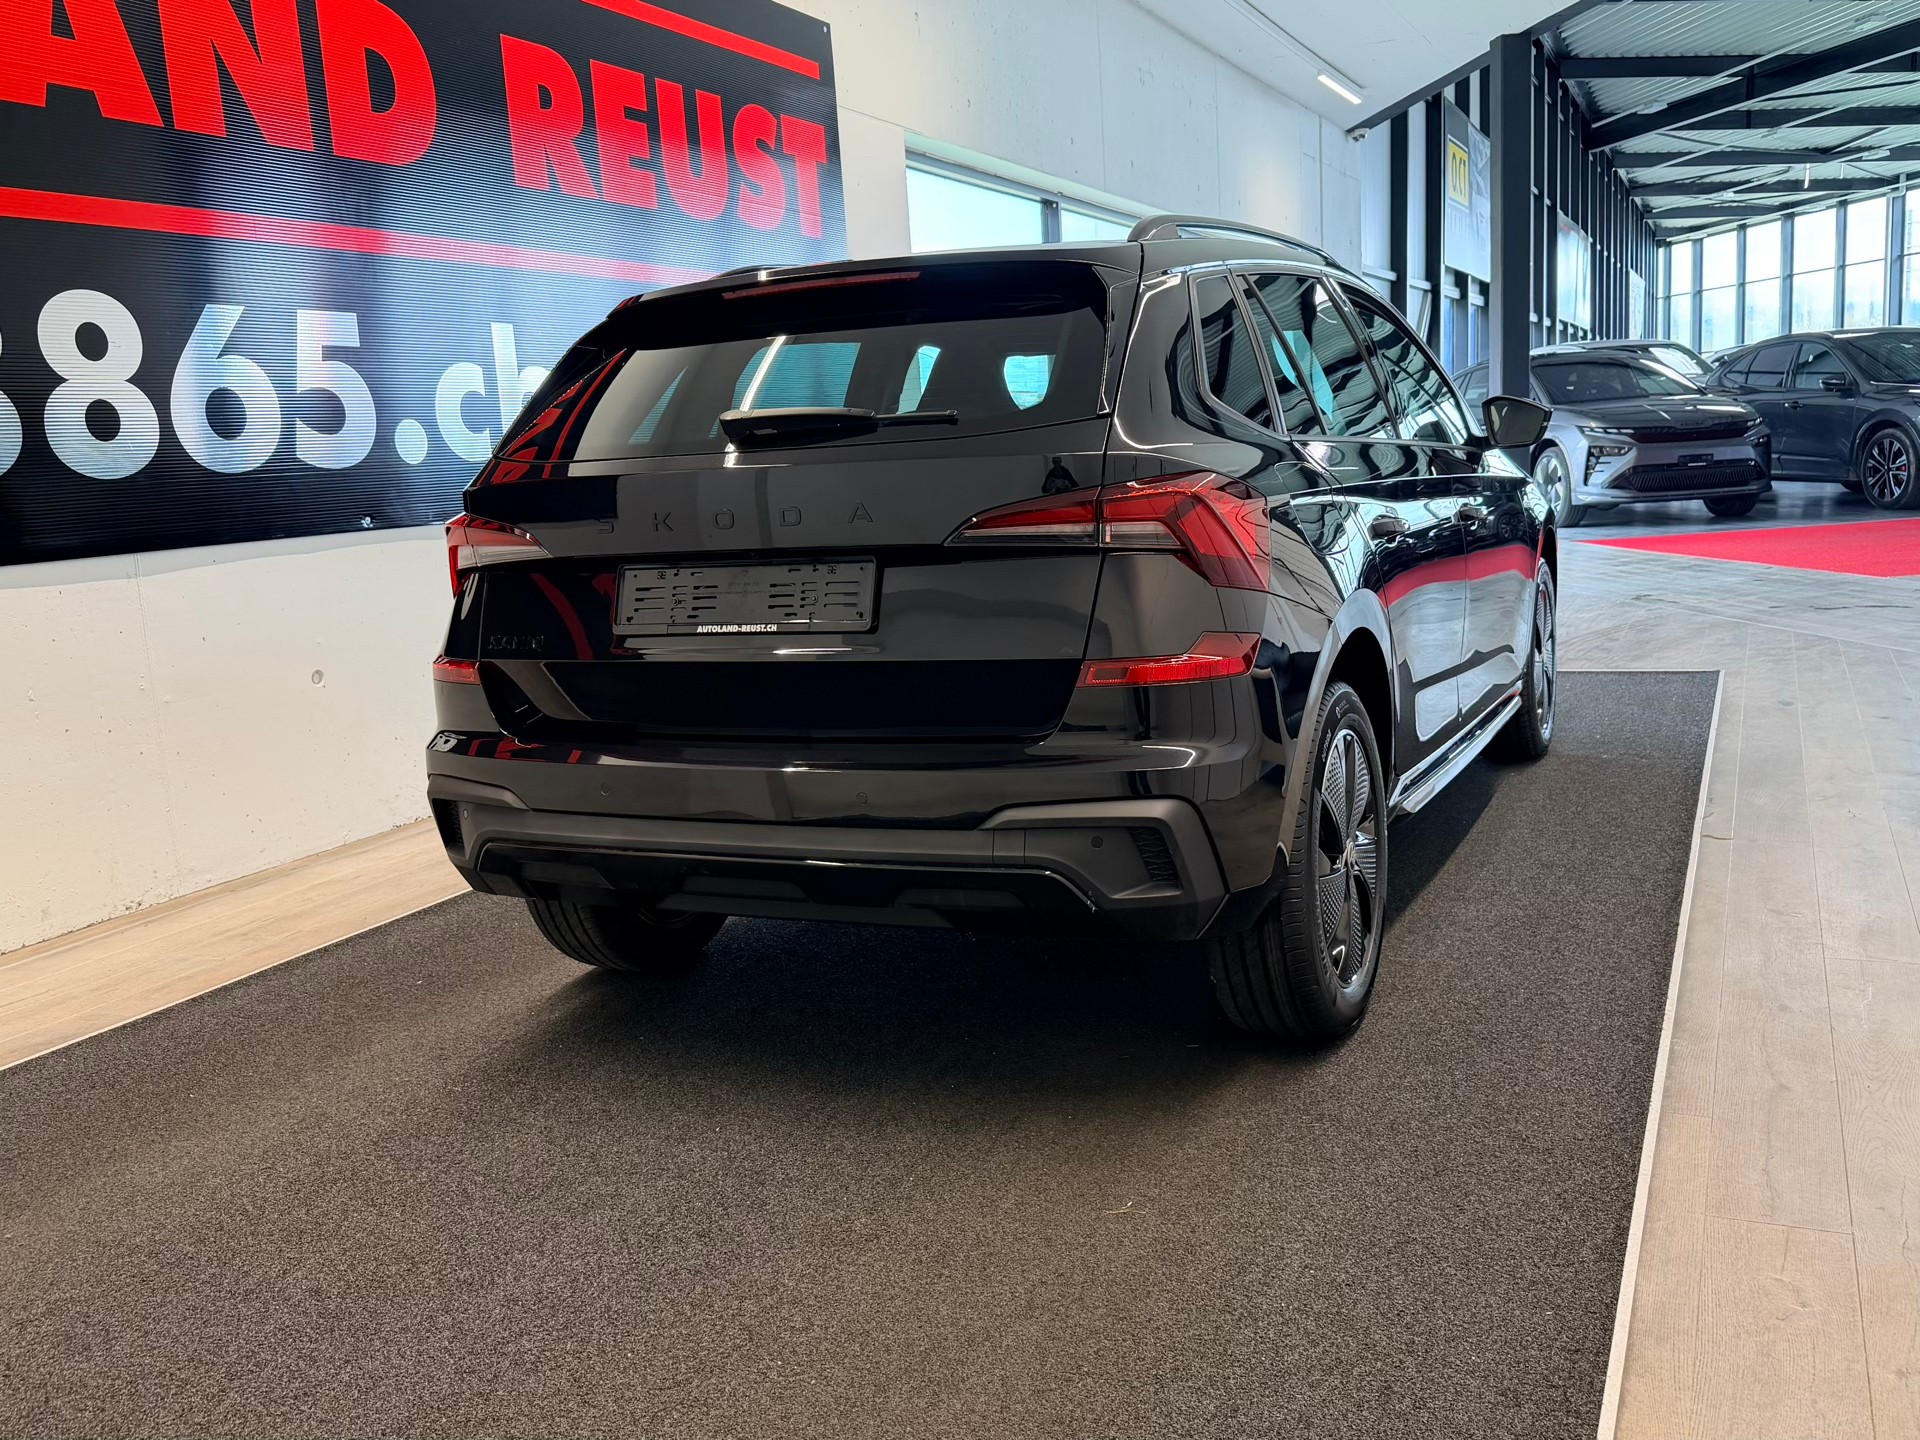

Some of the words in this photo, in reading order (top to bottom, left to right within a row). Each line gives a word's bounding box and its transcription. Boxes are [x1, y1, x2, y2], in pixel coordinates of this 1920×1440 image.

[500, 33, 827, 239] REUST
[0, 288, 551, 480] 865.ch
[696, 623, 778, 634] AUTOLAND-REUST.CH
